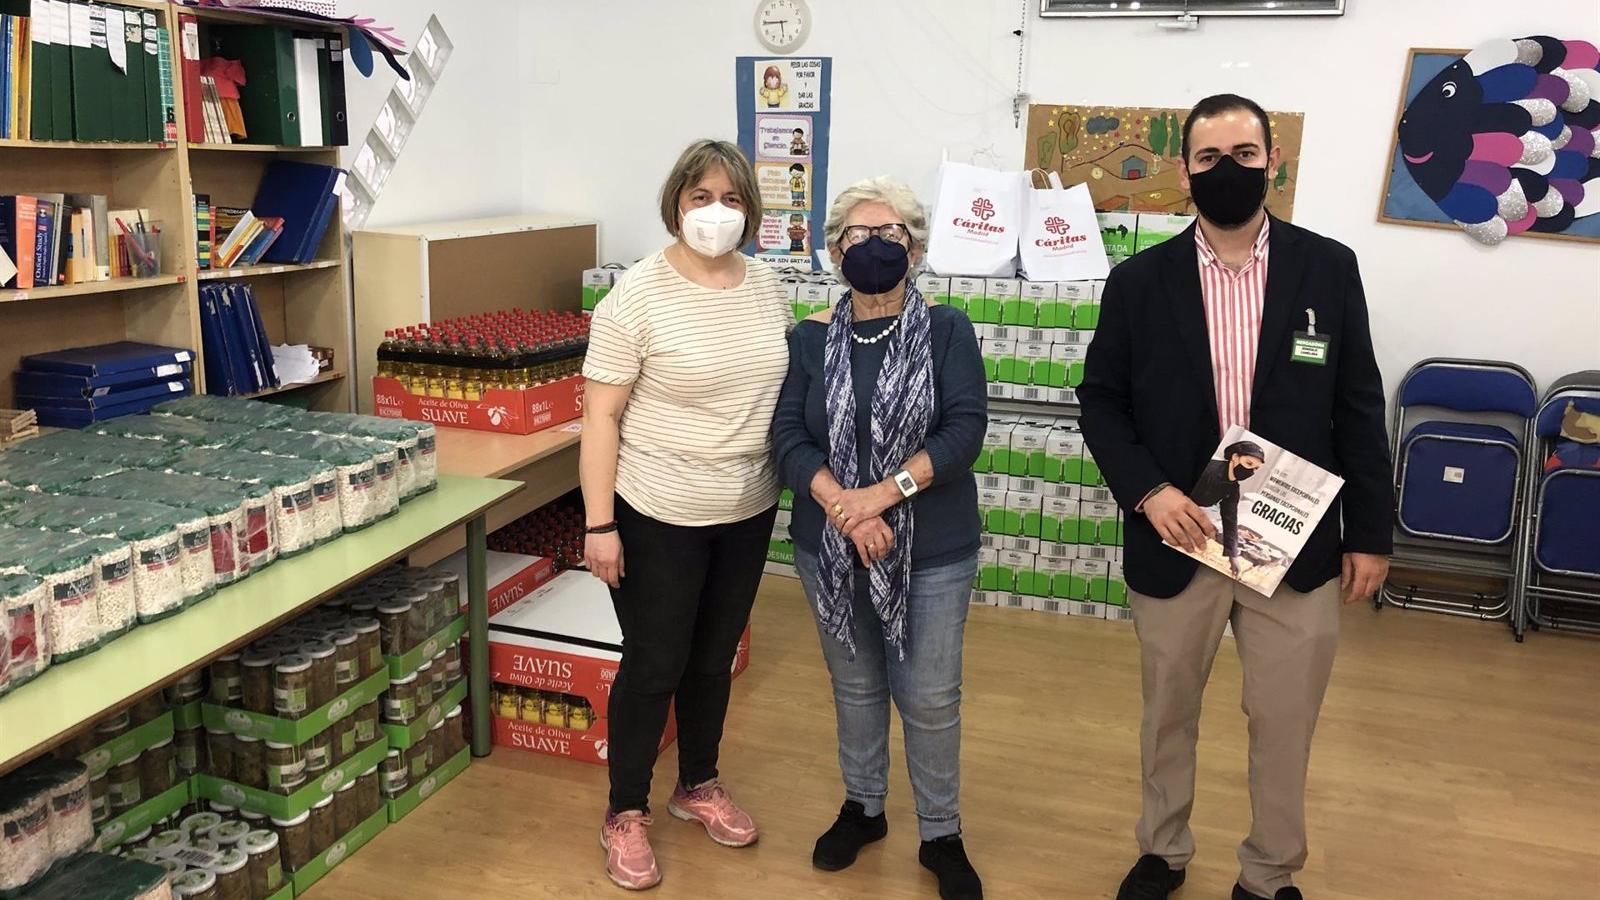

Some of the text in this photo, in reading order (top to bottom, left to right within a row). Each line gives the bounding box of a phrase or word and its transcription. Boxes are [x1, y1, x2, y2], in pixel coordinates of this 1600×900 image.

[952, 217, 1005, 234] Cáritas
[967, 228, 989, 237] Madrid
[1035, 234, 1087, 247] Cáritas
[1052, 244, 1074, 252] Madrid
[418, 398, 470, 410] Aceite de Oliva
[421, 408, 470, 425] SUAVE
[1251, 500, 1304, 535] GRACIAS
[492, 582, 524, 611] SUAVE
[513, 654, 573, 678] SUAVE
[510, 672, 574, 692] Aceite de Oliva
[508, 720, 571, 740] Aceite de Oliva
[512, 732, 571, 756] SUAVE
